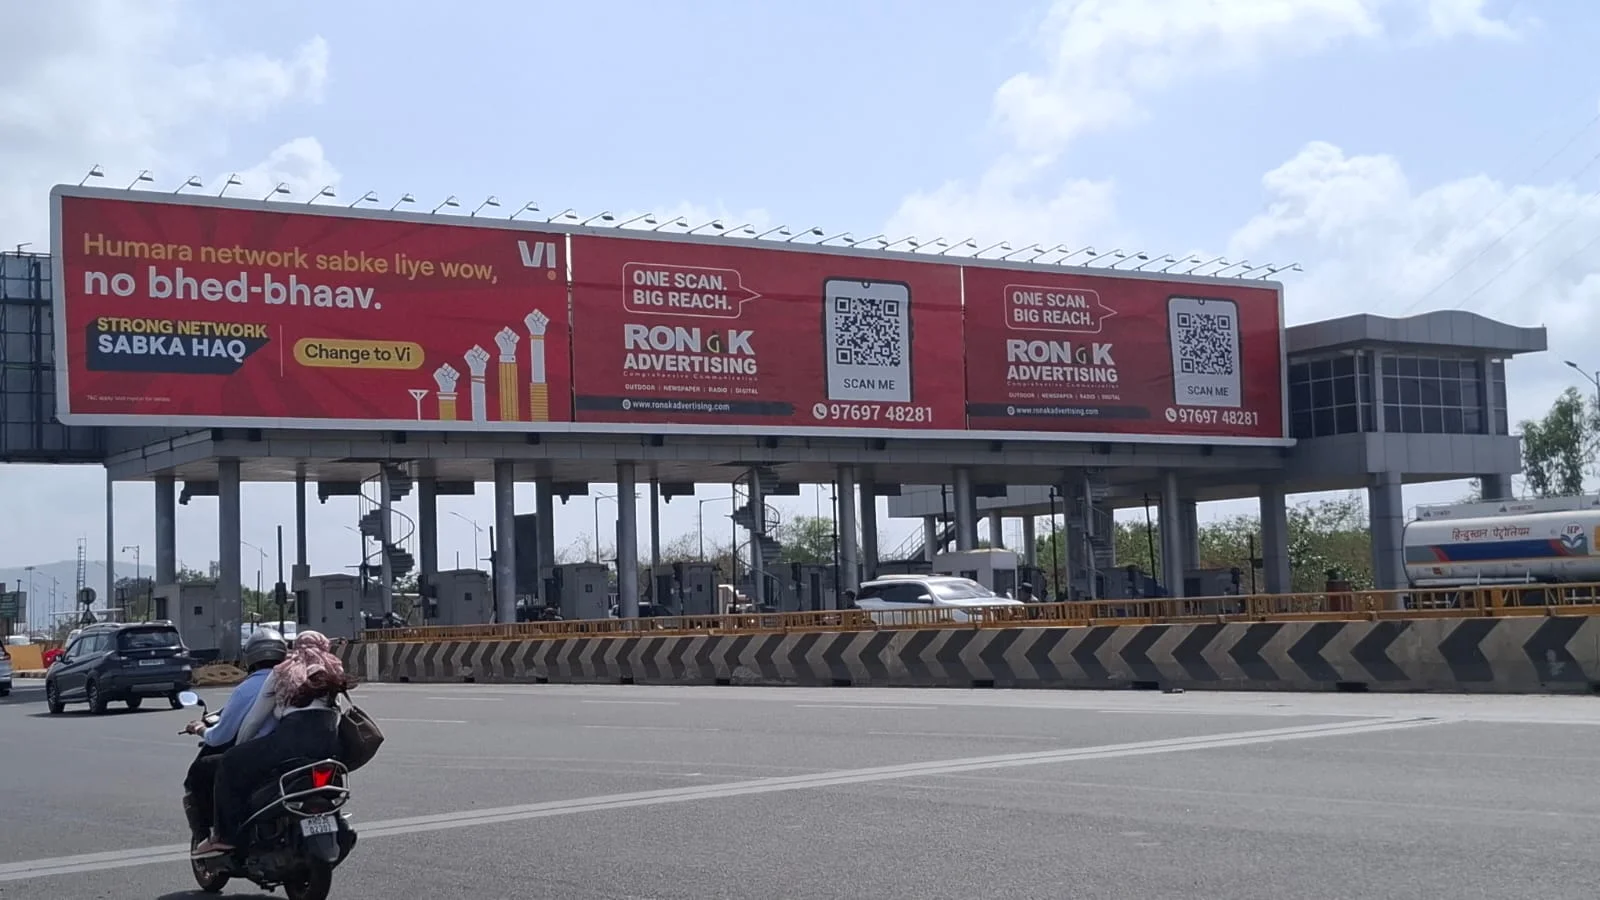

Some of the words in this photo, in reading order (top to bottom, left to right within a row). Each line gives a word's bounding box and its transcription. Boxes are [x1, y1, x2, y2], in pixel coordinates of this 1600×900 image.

[84, 232, 192, 261] Humara
[201, 247, 308, 269] network
[316, 250, 388, 273] sabke
[395, 253, 434, 280] liye
[440, 262, 498, 284] wow,
[85, 271, 136, 296] no
[149, 266, 382, 310] bhed-bhaav.
[633, 270, 670, 287] ONE
[674, 272, 728, 291] SCAN.
[632, 289, 664, 306] BIG
[668, 291, 733, 310] REACH.
[1012, 291, 1043, 306] ONE
[1047, 293, 1090, 309] SCAN.
[1013, 308, 1039, 323] BIG
[1043, 310, 1095, 326] REACH.
[97, 316, 173, 334] STRONG
[177, 321, 268, 338] NETWORK
[98, 334, 186, 356] SABKA
[191, 338, 246, 363] HAQ
[304, 343, 370, 364] Change
[373, 346, 391, 361] to
[395, 346, 410, 362] Vi
[623, 353, 757, 375] ADVERTISING
[1007, 365, 1118, 383] ADVERTISING
[625, 383, 655, 391] OUTDOOR
[663, 385, 700, 393] NEWSPAPER
[843, 378, 875, 389] SCAN
[878, 379, 895, 390] ME
[1187, 385, 1213, 396] SCAN
[1215, 387, 1229, 397] ME
[632, 400, 730, 412] www.ronakadvertising.com
[830, 404, 881, 421] 97697
[885, 405, 933, 422] 48281
[1178, 408, 1218, 424] 97697
[1221, 411, 1259, 426] 48281
[1566, 525, 1580, 535] HP
